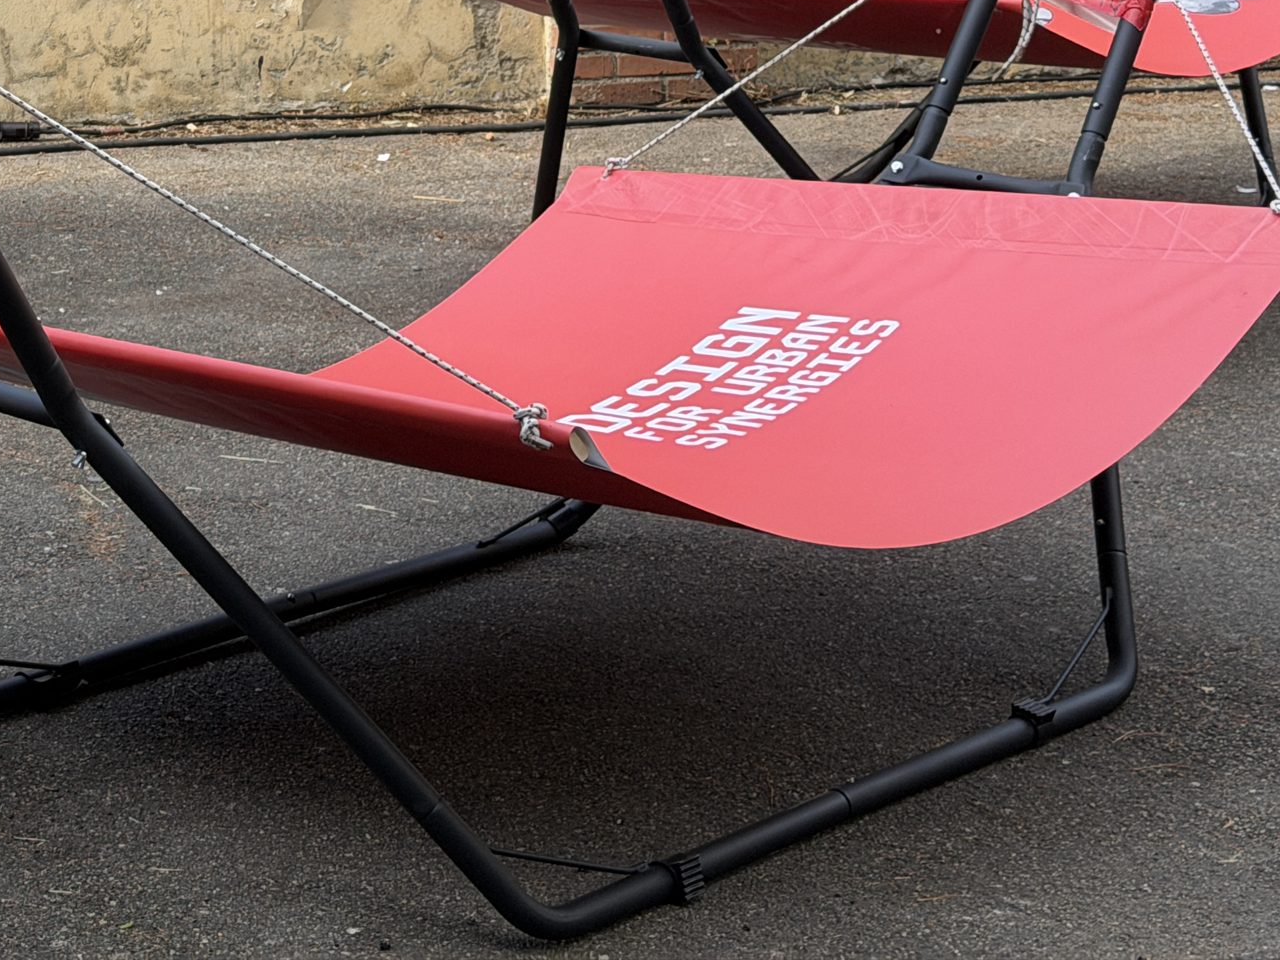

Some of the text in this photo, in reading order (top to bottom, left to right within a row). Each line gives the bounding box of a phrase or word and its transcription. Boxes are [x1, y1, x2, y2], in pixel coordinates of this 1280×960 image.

[555, 306, 801, 434] DESIGN
[623, 313, 850, 442] FOR URBAN
[675, 319, 900, 450] SYNERGIES
